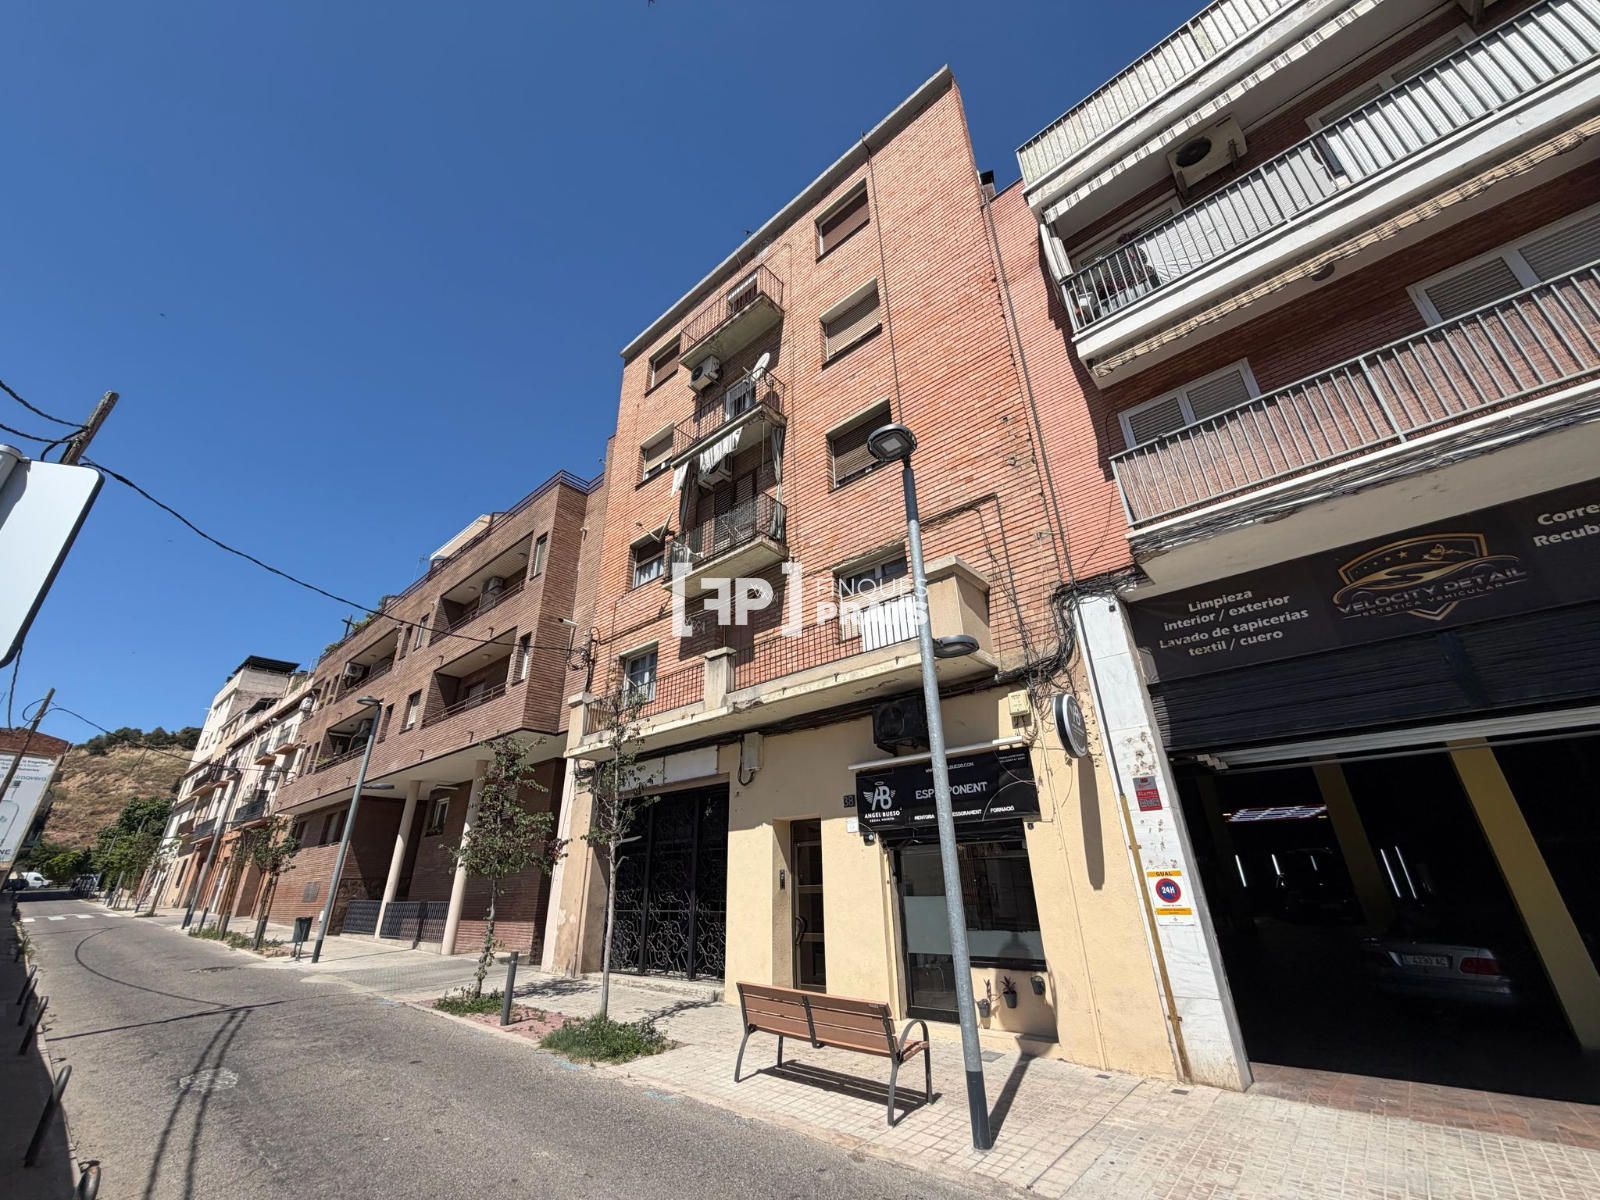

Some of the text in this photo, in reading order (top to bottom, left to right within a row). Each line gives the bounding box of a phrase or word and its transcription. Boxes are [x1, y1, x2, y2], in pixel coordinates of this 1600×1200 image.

[1537, 504, 1600, 525] Corre
[1533, 524, 1600, 547] Recub
[1188, 590, 1253, 613] Limpieza
[1336, 567, 1527, 614] VELOCITY DETAIL
[1427, 583, 1504, 602] VEHICULAR
[1163, 611, 1216, 632] interior
[1228, 594, 1291, 617] exterior
[1158, 609, 1309, 649] Lavado de tapicerias
[1188, 640, 1227, 657] textil
[1239, 630, 1284, 646] cuero
[864, 811, 881, 819] ANGEL
[1161, 885, 1175, 894] 24H
